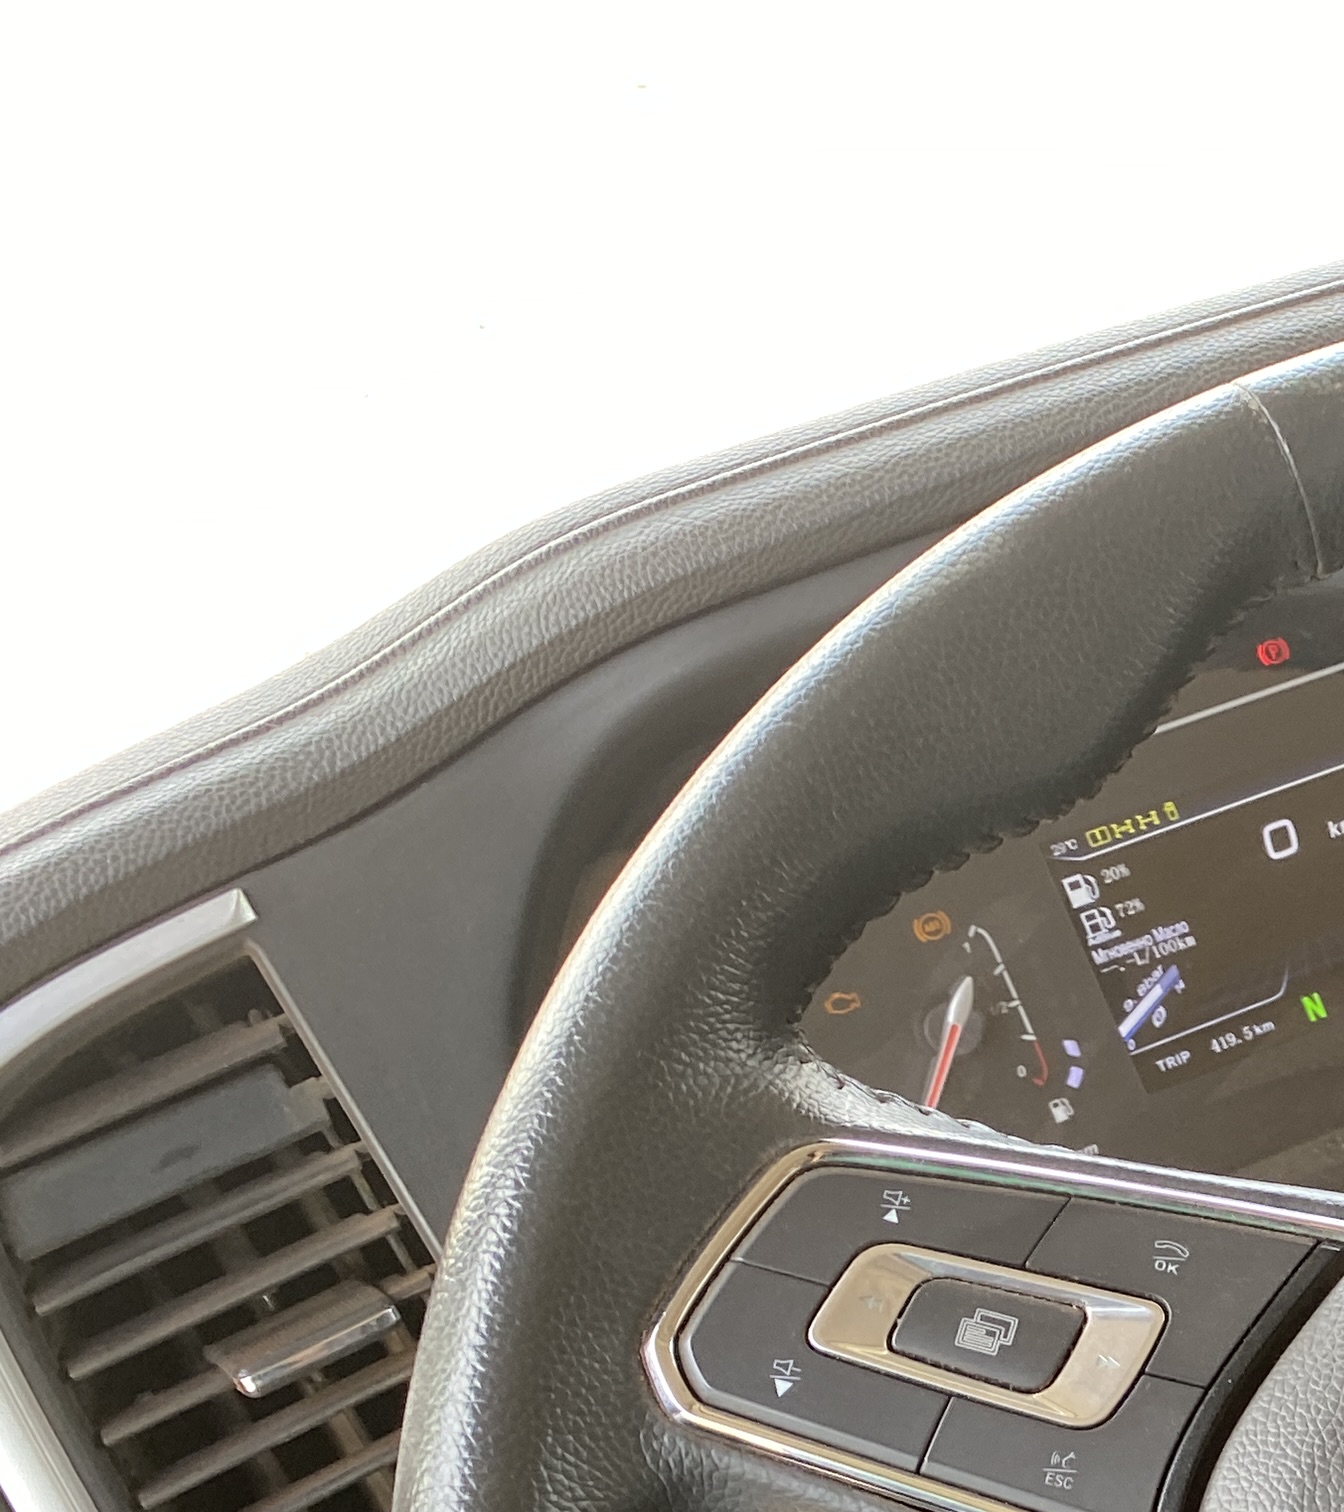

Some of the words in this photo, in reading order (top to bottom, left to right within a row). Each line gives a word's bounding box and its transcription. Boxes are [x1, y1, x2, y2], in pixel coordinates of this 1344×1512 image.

[1263, 819, 1298, 860] 0
[1101, 863, 1131, 884] 20%
[1301, 992, 1327, 1022] N
[1155, 1050, 1191, 1072] TRIP
[1154, 1258, 1178, 1275] OK
[1044, 1472, 1074, 1490] ESC
